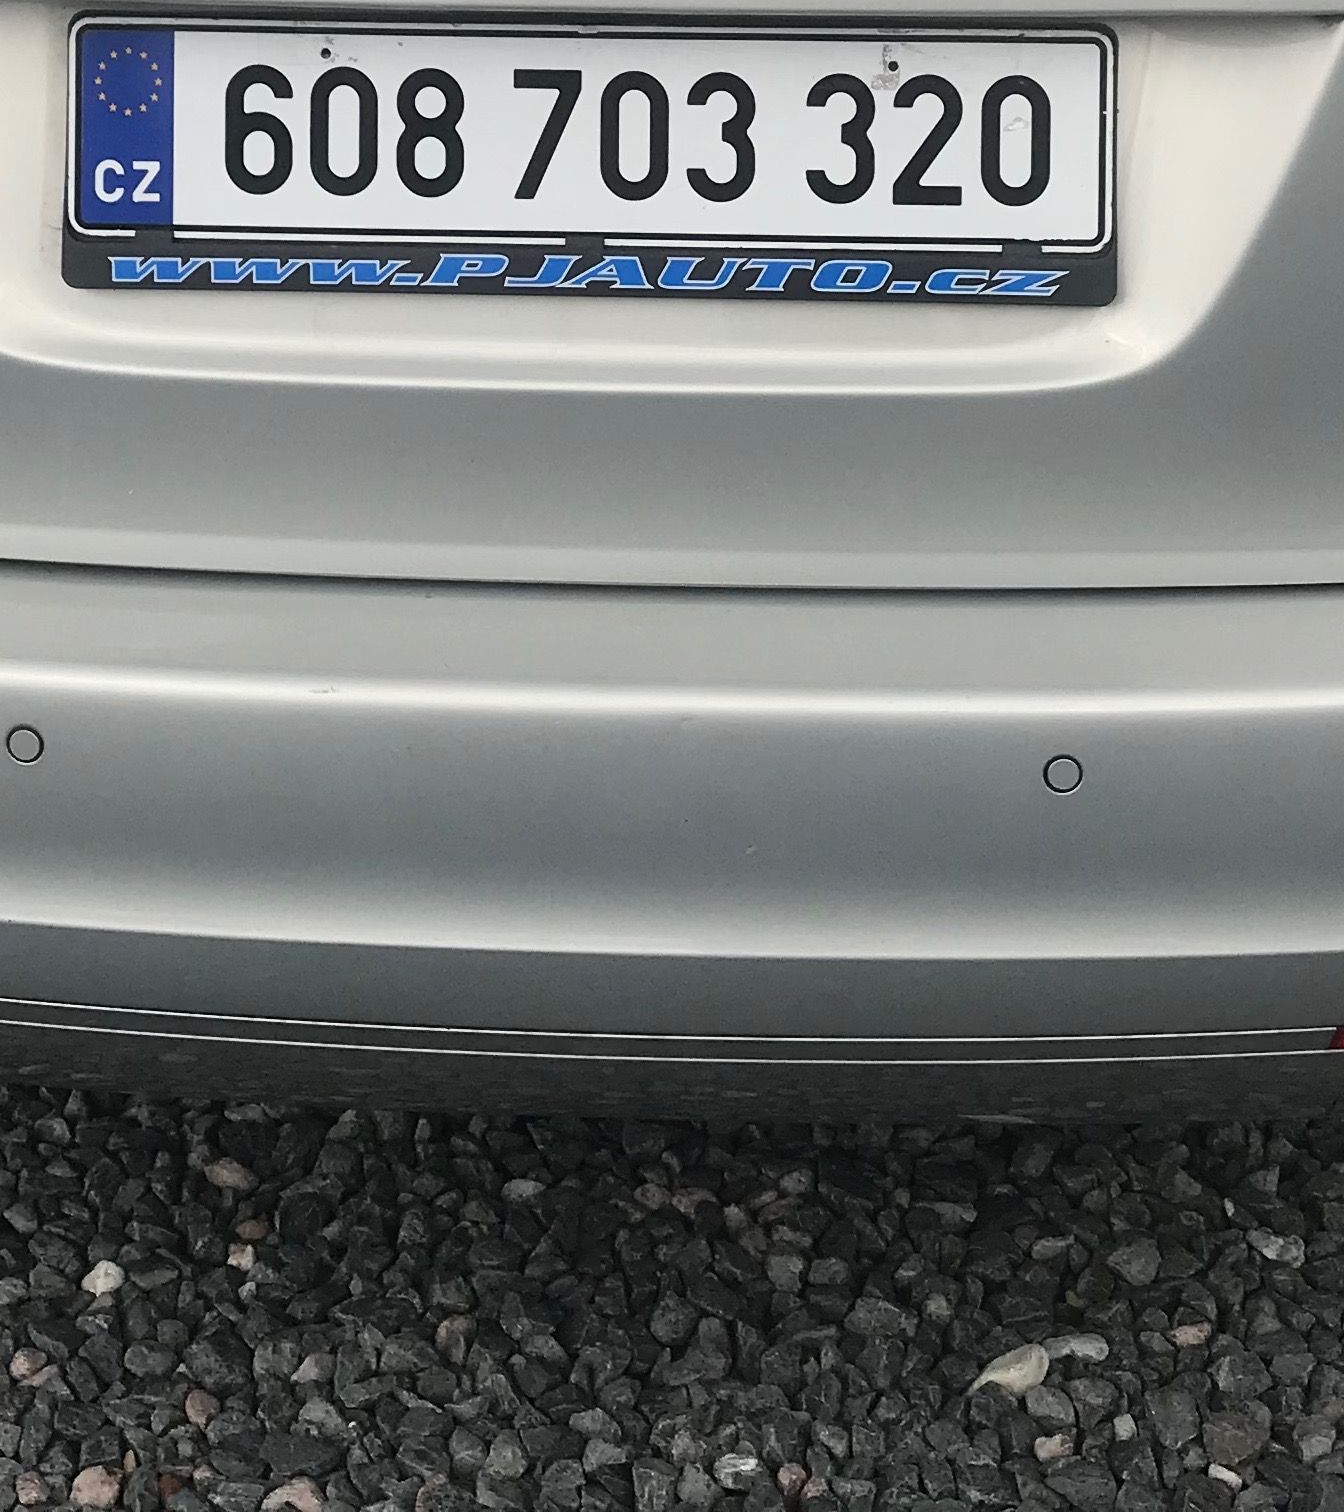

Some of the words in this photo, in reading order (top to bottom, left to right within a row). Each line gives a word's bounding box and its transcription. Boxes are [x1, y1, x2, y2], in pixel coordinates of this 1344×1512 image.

[94, 158, 162, 204] CZ
[223, 64, 466, 198] 608
[512, 68, 757, 203] 703
[804, 73, 1052, 207] 320
